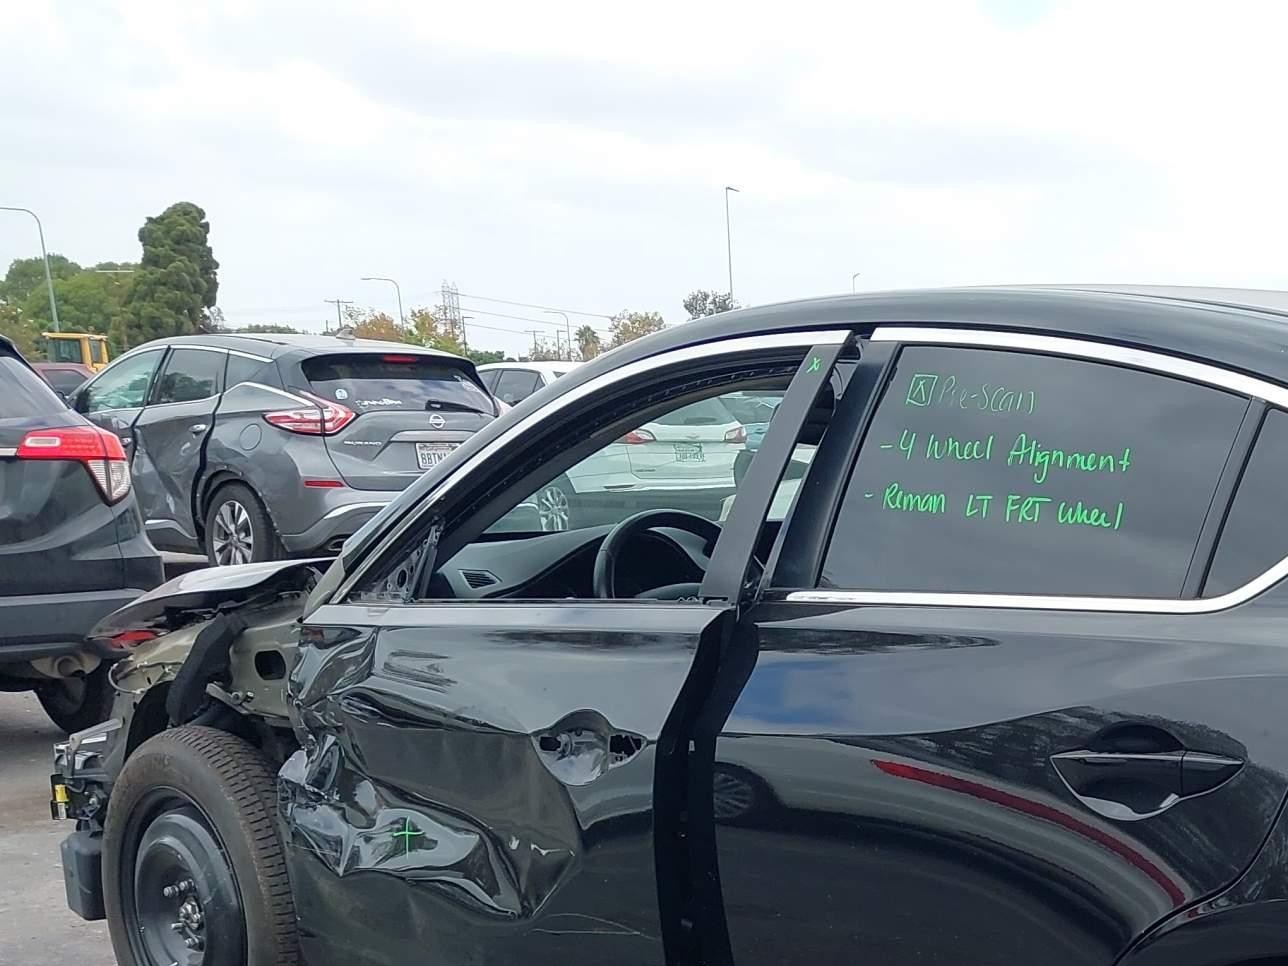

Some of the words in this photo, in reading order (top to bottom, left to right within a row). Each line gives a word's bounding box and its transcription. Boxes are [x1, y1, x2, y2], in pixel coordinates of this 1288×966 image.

[421, 451, 447, 466] 8BTN
[899, 429, 916, 460] 4
[1007, 433, 1131, 484] Alignment
[882, 483, 946, 513] Reman
[966, 495, 993, 518] LT
[1005, 495, 1052, 523] FRT
